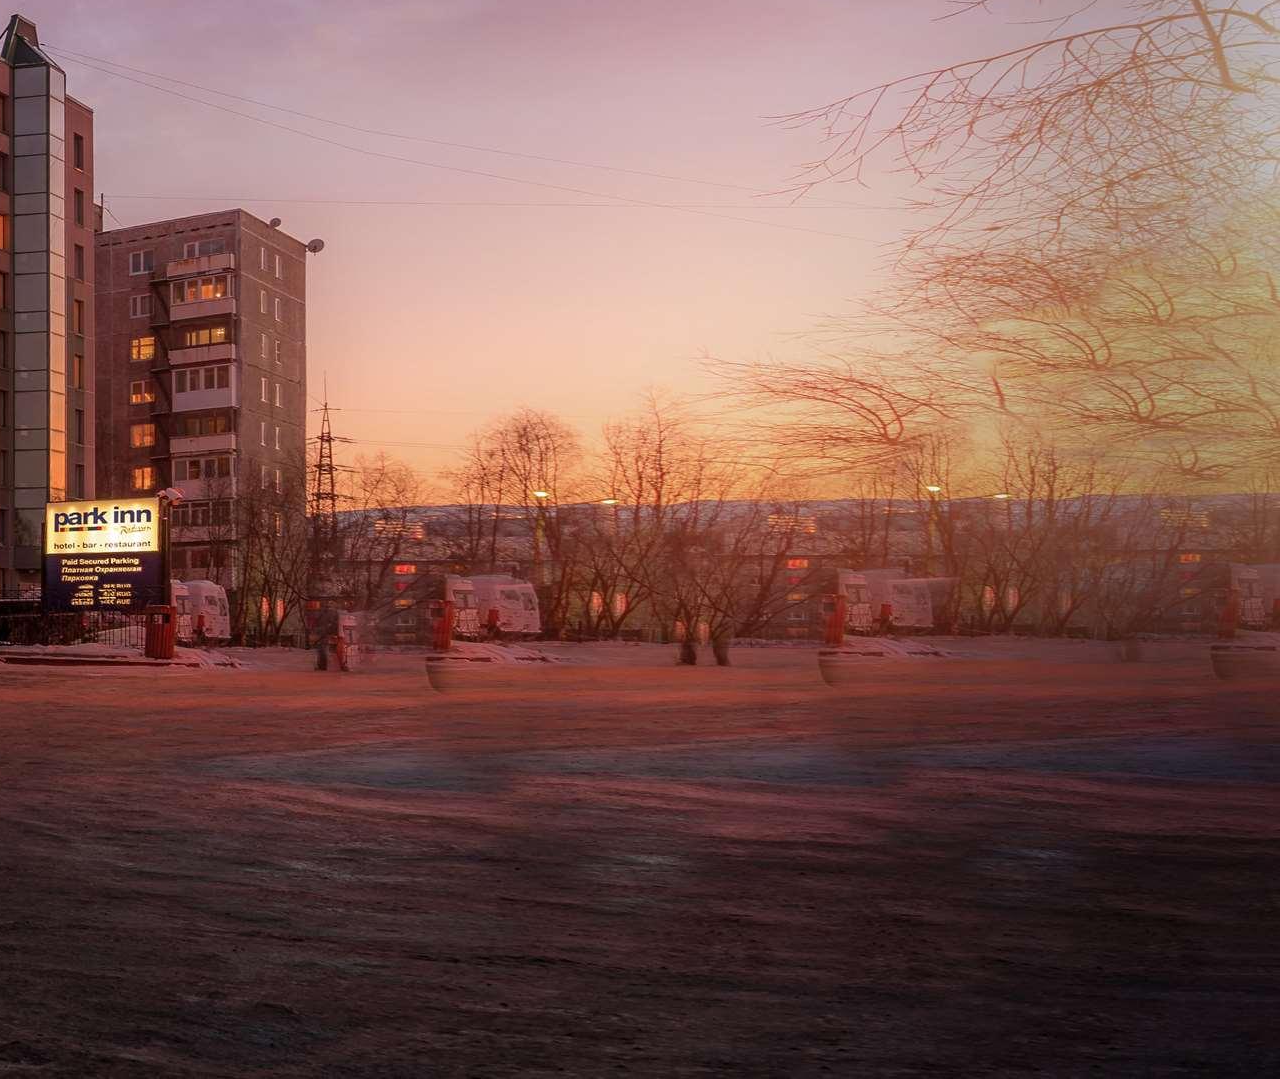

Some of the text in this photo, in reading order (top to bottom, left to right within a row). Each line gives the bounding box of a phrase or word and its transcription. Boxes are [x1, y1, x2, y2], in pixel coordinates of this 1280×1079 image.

[54, 506, 152, 532] park inn
[53, 542, 75, 550] hotel
[104, 540, 151, 548] restaurant
[110, 557, 139, 565] Parking
